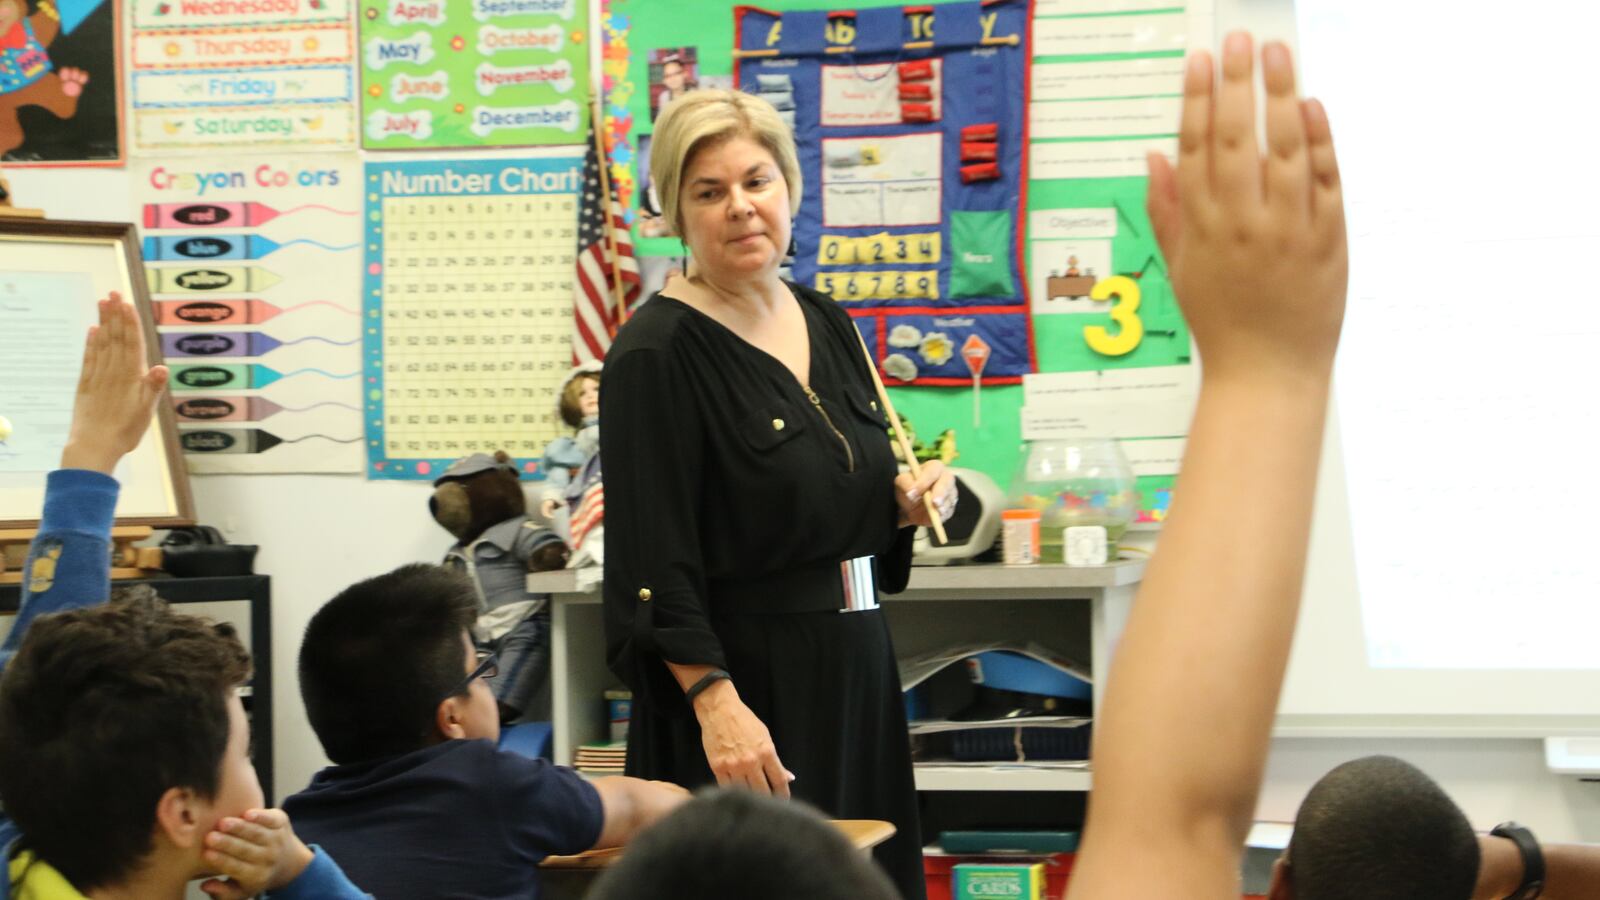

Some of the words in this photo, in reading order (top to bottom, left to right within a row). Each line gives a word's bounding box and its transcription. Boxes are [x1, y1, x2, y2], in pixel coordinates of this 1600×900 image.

[181, 0, 299, 15] Wednesday
[394, 1, 439, 19] April
[479, 0, 567, 12] September
[193, 38, 291, 56] Thursday
[484, 32, 559, 47] October
[378, 42, 421, 60] May
[481, 67, 568, 85] November
[208, 76, 276, 97] Friday
[397, 78, 443, 96] June
[194, 115, 293, 136] Saturday
[384, 115, 419, 133] July
[479, 109, 572, 126] December
[383, 169, 494, 194] Number
[500, 167, 579, 192] Chart
[825, 242, 839, 260] 0
[853, 244, 859, 261] 1
[872, 243, 884, 261] 2
[896, 240, 907, 259] 3
[918, 240, 931, 257] 4
[824, 277, 835, 295] 5
[847, 277, 858, 296] 6
[871, 277, 882, 294] 7
[895, 276, 906, 294] 8
[918, 277, 930, 295] 9
[1083, 275, 1143, 356] 3
